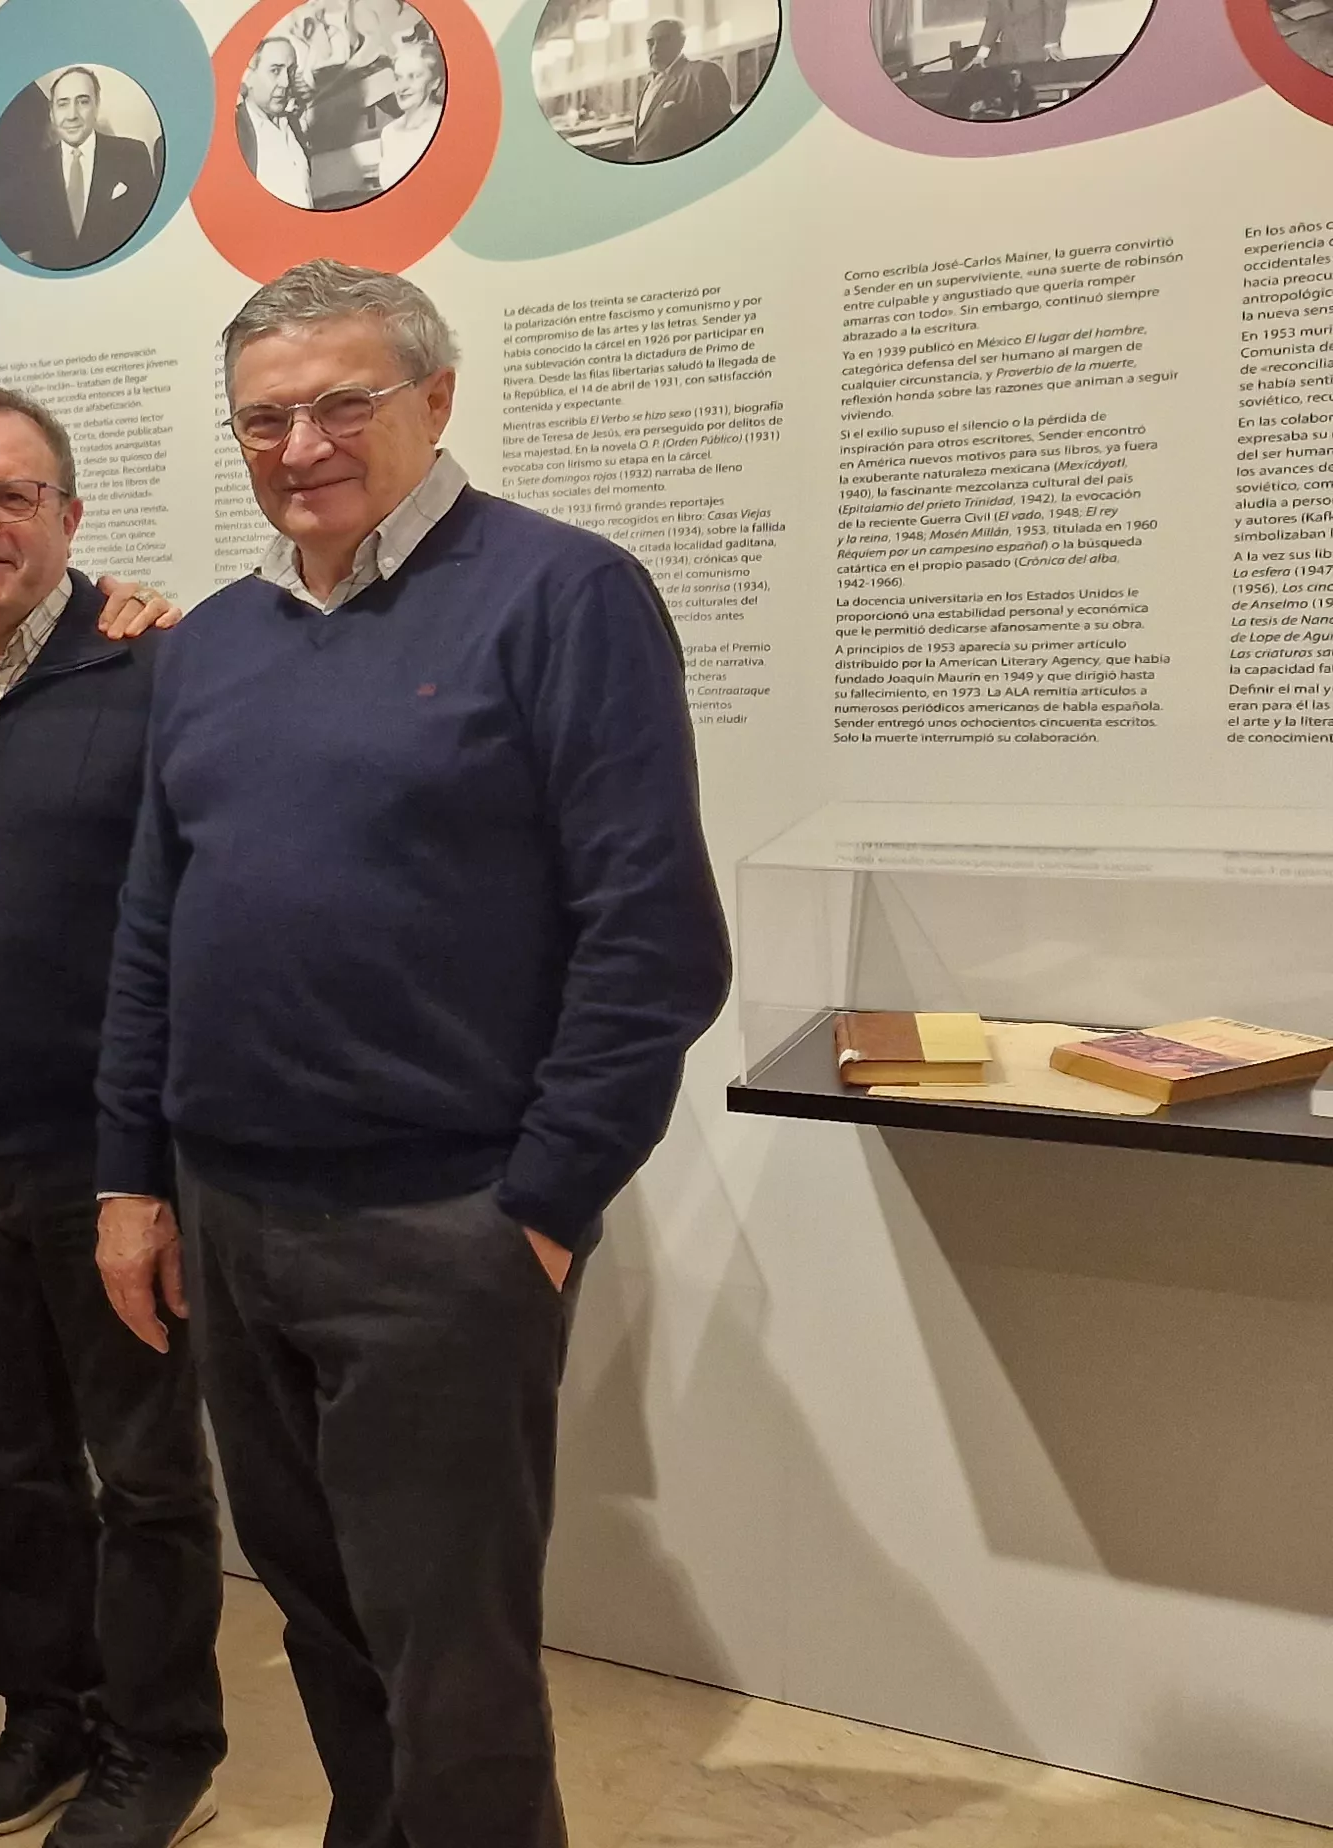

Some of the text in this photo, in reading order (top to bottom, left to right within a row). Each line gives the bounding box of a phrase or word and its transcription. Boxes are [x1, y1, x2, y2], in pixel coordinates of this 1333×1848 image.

[1244, 237, 1325, 256] experiencia
[844, 270, 879, 281] Como
[931, 255, 1002, 272] José-Carlos
[1005, 251, 1051, 263] Mainer,
[1054, 247, 1065, 258] la
[1068, 244, 1111, 259] guerra
[1114, 236, 1173, 252] convirtió
[503, 286, 721, 317] La década de los treinta se caracterizó por
[1240, 343, 1315, 358] Comunista
[1233, 551, 1310, 561] A la vez sus
[834, 644, 843, 655] A
[846, 643, 904, 656] principios
[907, 643, 922, 653] de
[927, 642, 955, 653] 1953
[1012, 643, 1027, 651] su
[1031, 640, 1074, 652] primer
[1228, 699, 1330, 713] eran para él las
[833, 732, 1099, 744] Solo la muerte interrumpió su colaboración.
